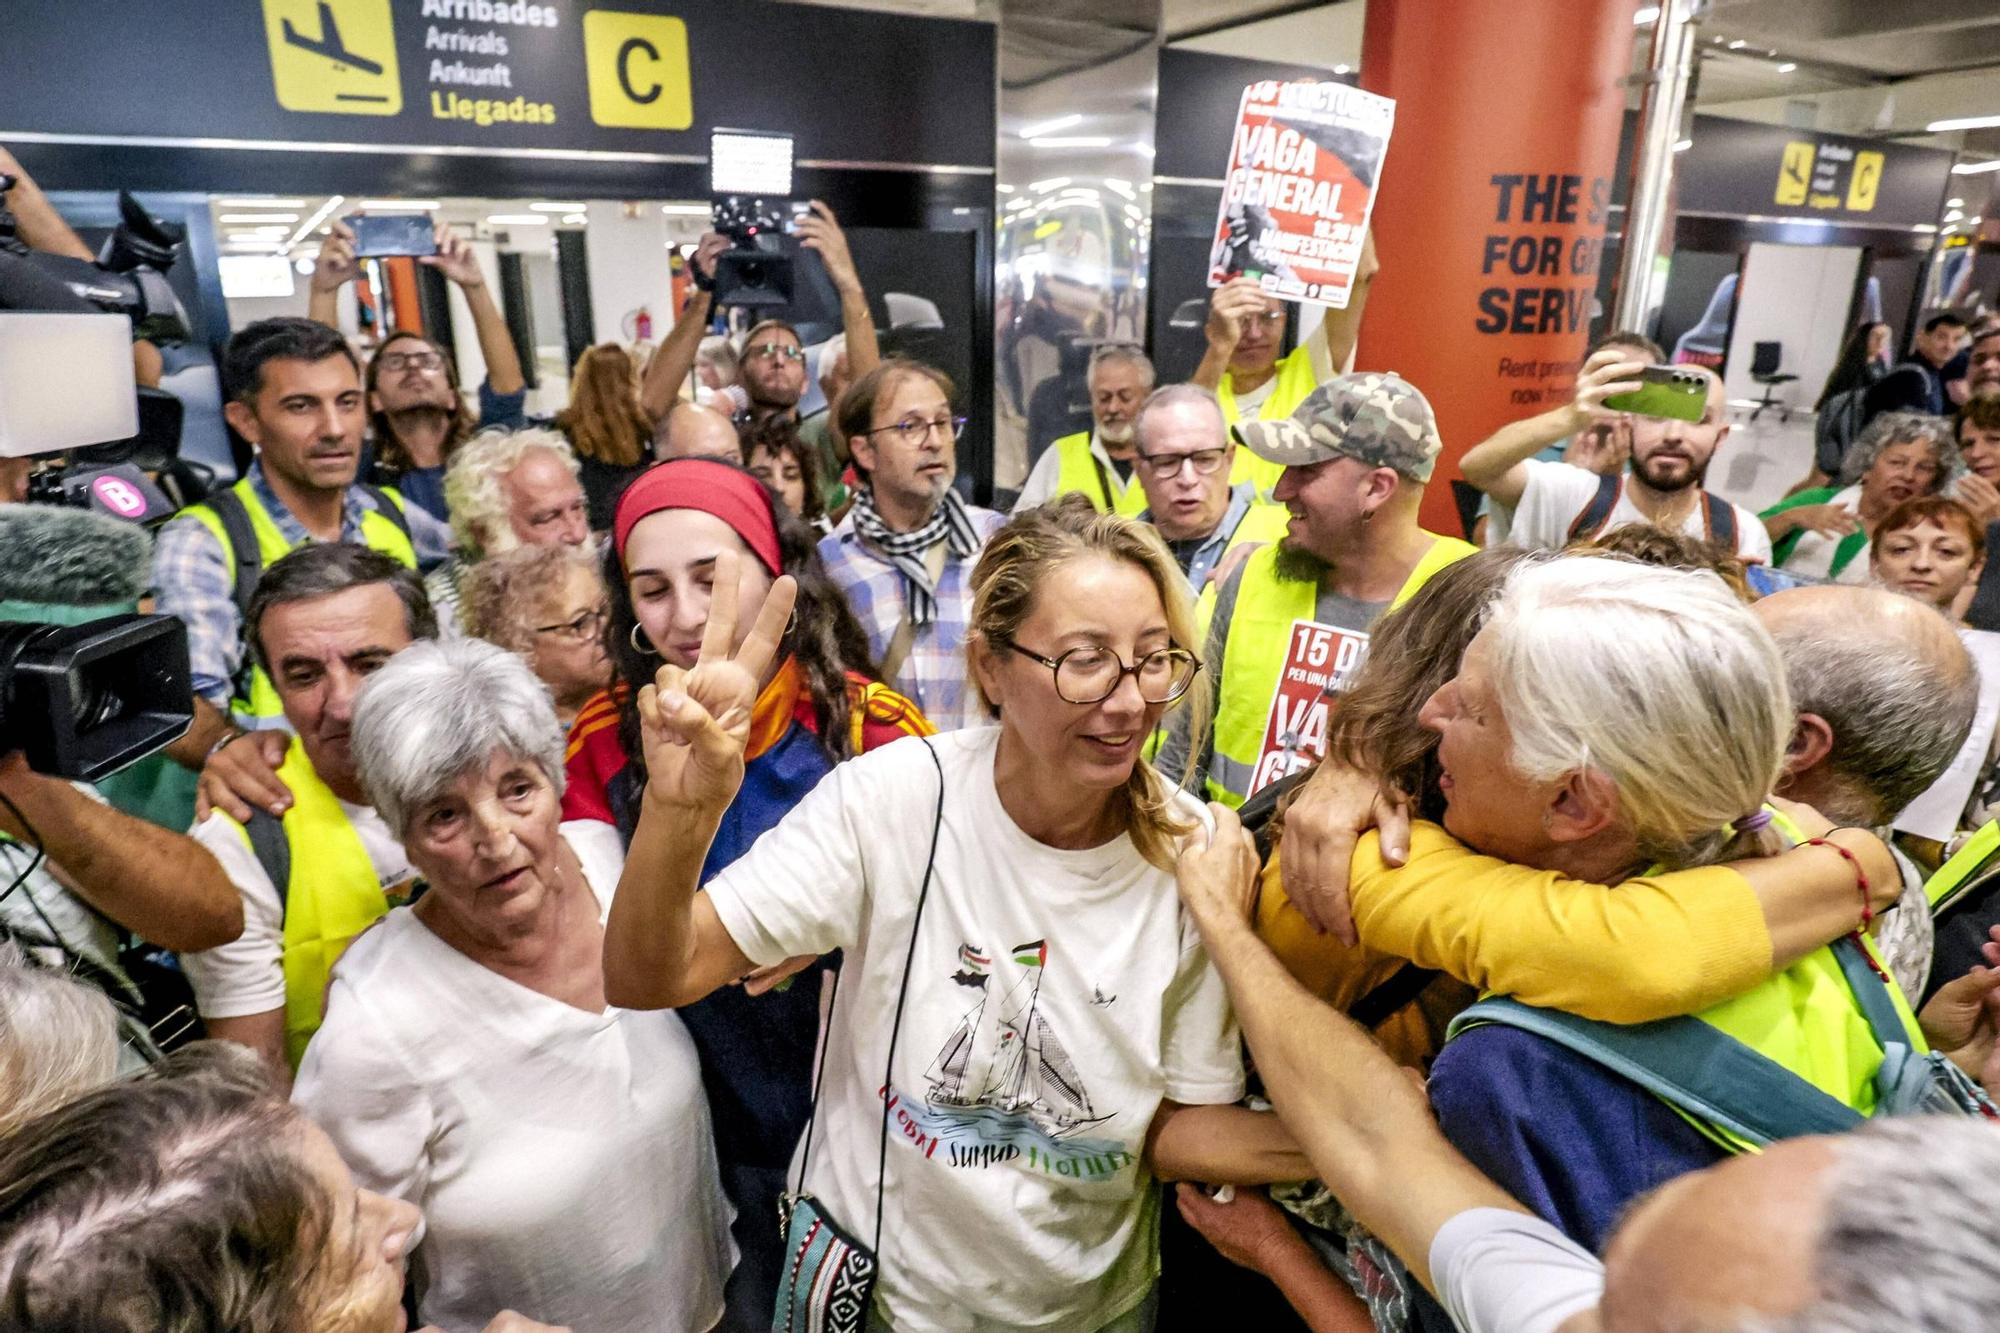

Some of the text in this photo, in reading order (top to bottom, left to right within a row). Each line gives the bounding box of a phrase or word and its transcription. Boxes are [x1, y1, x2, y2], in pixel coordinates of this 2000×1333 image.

[422, 0, 560, 28] Arribades
[426, 26, 509, 55] Arrivals
[430, 58, 512, 87] Ankunft
[616, 37, 663, 105] C
[432, 92, 556, 126] Llegadas
[1238, 125, 1317, 175] VAGA
[1228, 167, 1344, 221] GENERAL
[1490, 174, 1583, 224] THE
[1858, 164, 1873, 198] C
[1482, 236, 1563, 276] FOR
[1475, 287, 1588, 335] SERV
[1499, 357, 1537, 378] Rent
[1296, 627, 1369, 673] 15 D'
[1287, 667, 1308, 684] PER
[1306, 671, 1327, 689] UNA
[1275, 694, 1329, 758] VA
[1256, 749, 1312, 794] G
[948, 1142, 1021, 1170] SUMUD
